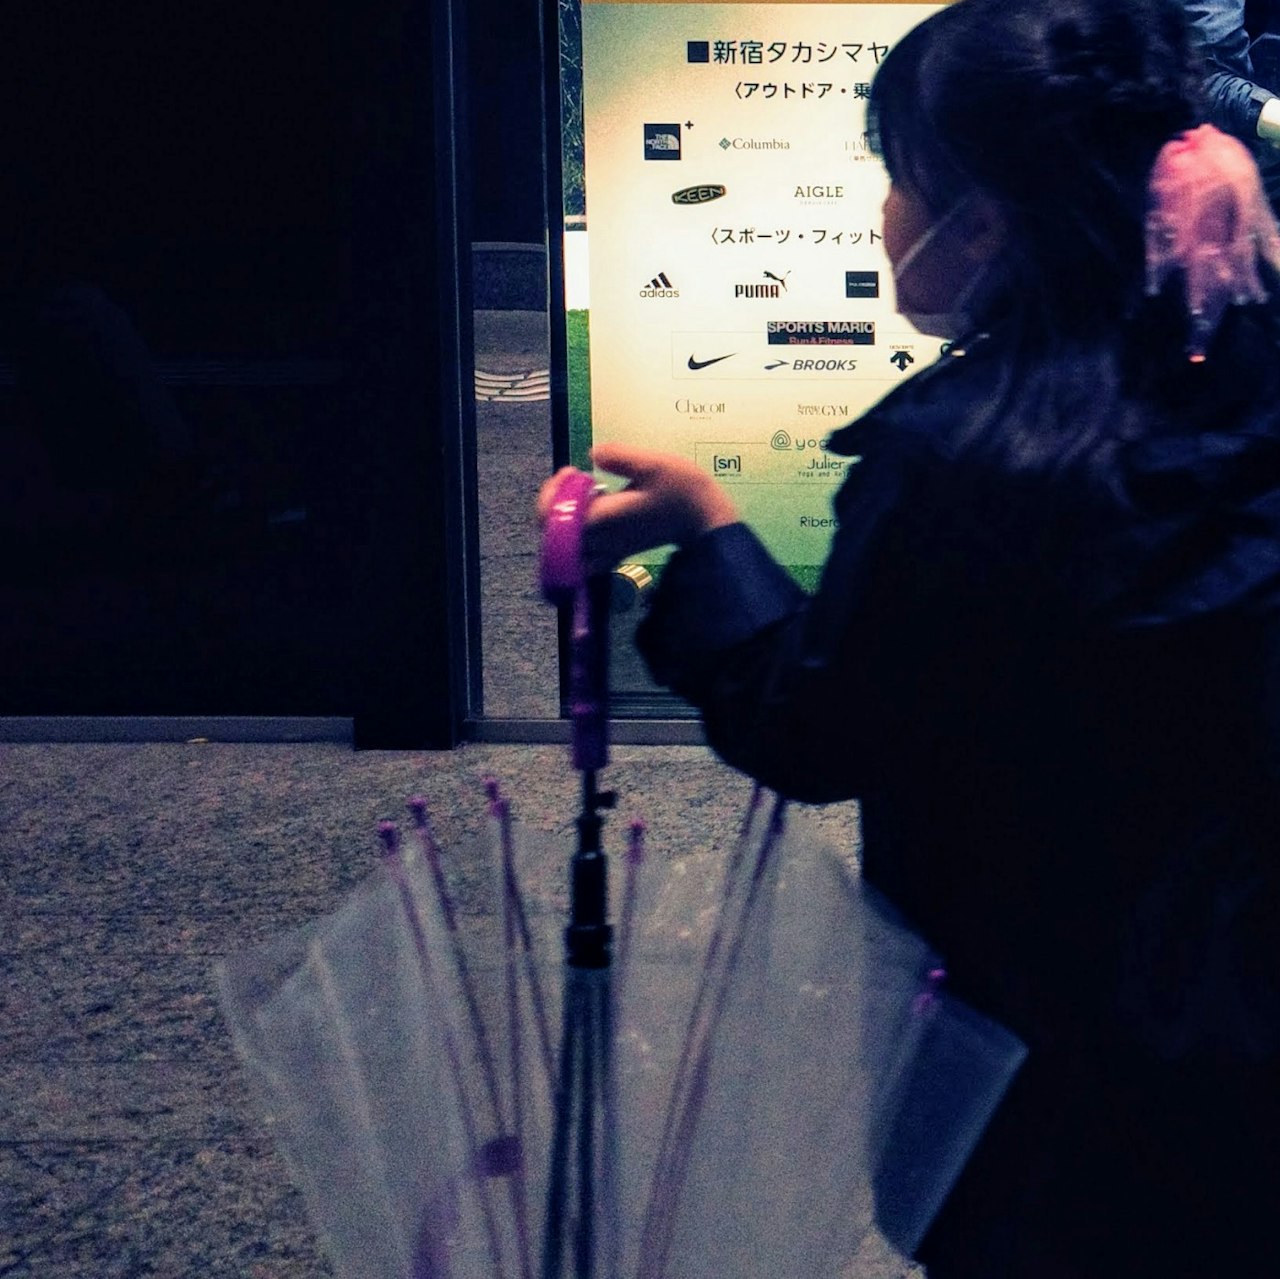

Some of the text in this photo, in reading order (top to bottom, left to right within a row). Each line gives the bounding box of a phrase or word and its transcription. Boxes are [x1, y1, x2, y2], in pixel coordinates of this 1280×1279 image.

[732, 138, 791, 150] Columbia
[674, 186, 725, 203] KEEN
[794, 186, 844, 198] AIGLE
[639, 289, 680, 298] adidas
[735, 284, 779, 298] PUMA
[768, 322, 875, 334] SPORTS MARIO
[793, 360, 858, 371] BROOKS
